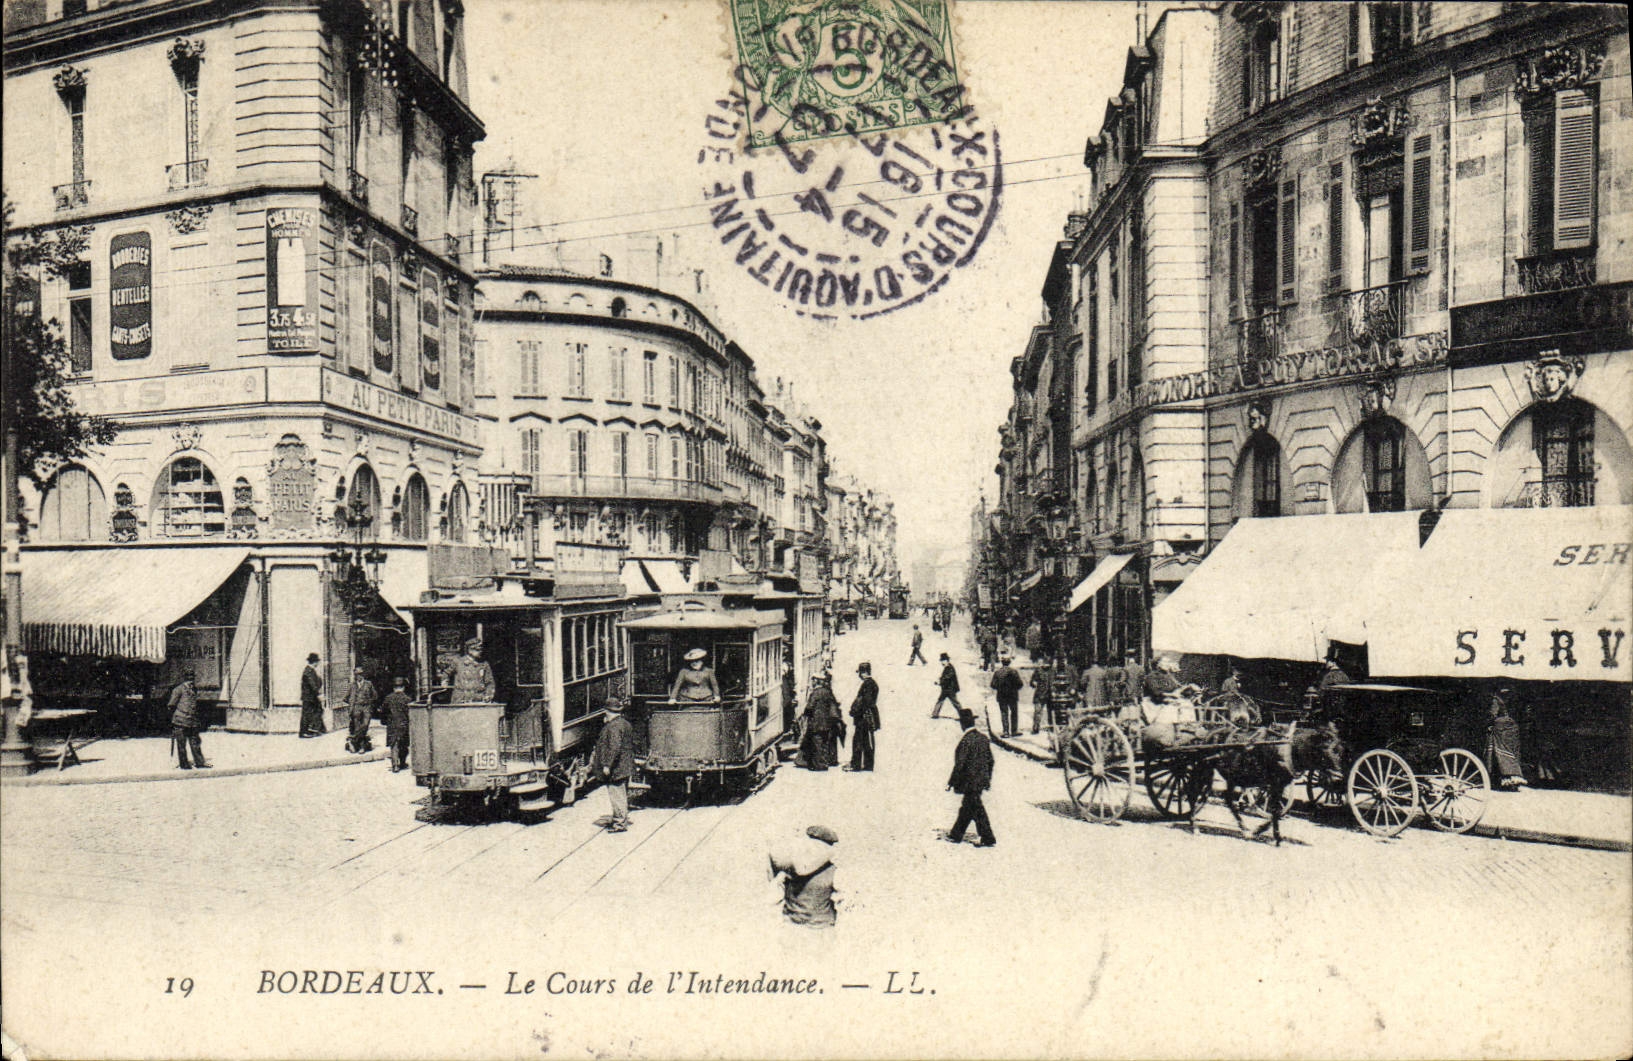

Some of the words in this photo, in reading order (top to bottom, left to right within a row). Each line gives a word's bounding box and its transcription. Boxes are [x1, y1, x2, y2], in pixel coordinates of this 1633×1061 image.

[807, 98, 902, 136] POSTES
[351, 383, 371, 411] AU
[376, 389, 420, 426] PETIT
[423, 405, 462, 437] PARIS
[270, 499, 310, 512] PARIS
[271, 483, 313, 496] PETIT
[1454, 626, 1625, 669] SERV
